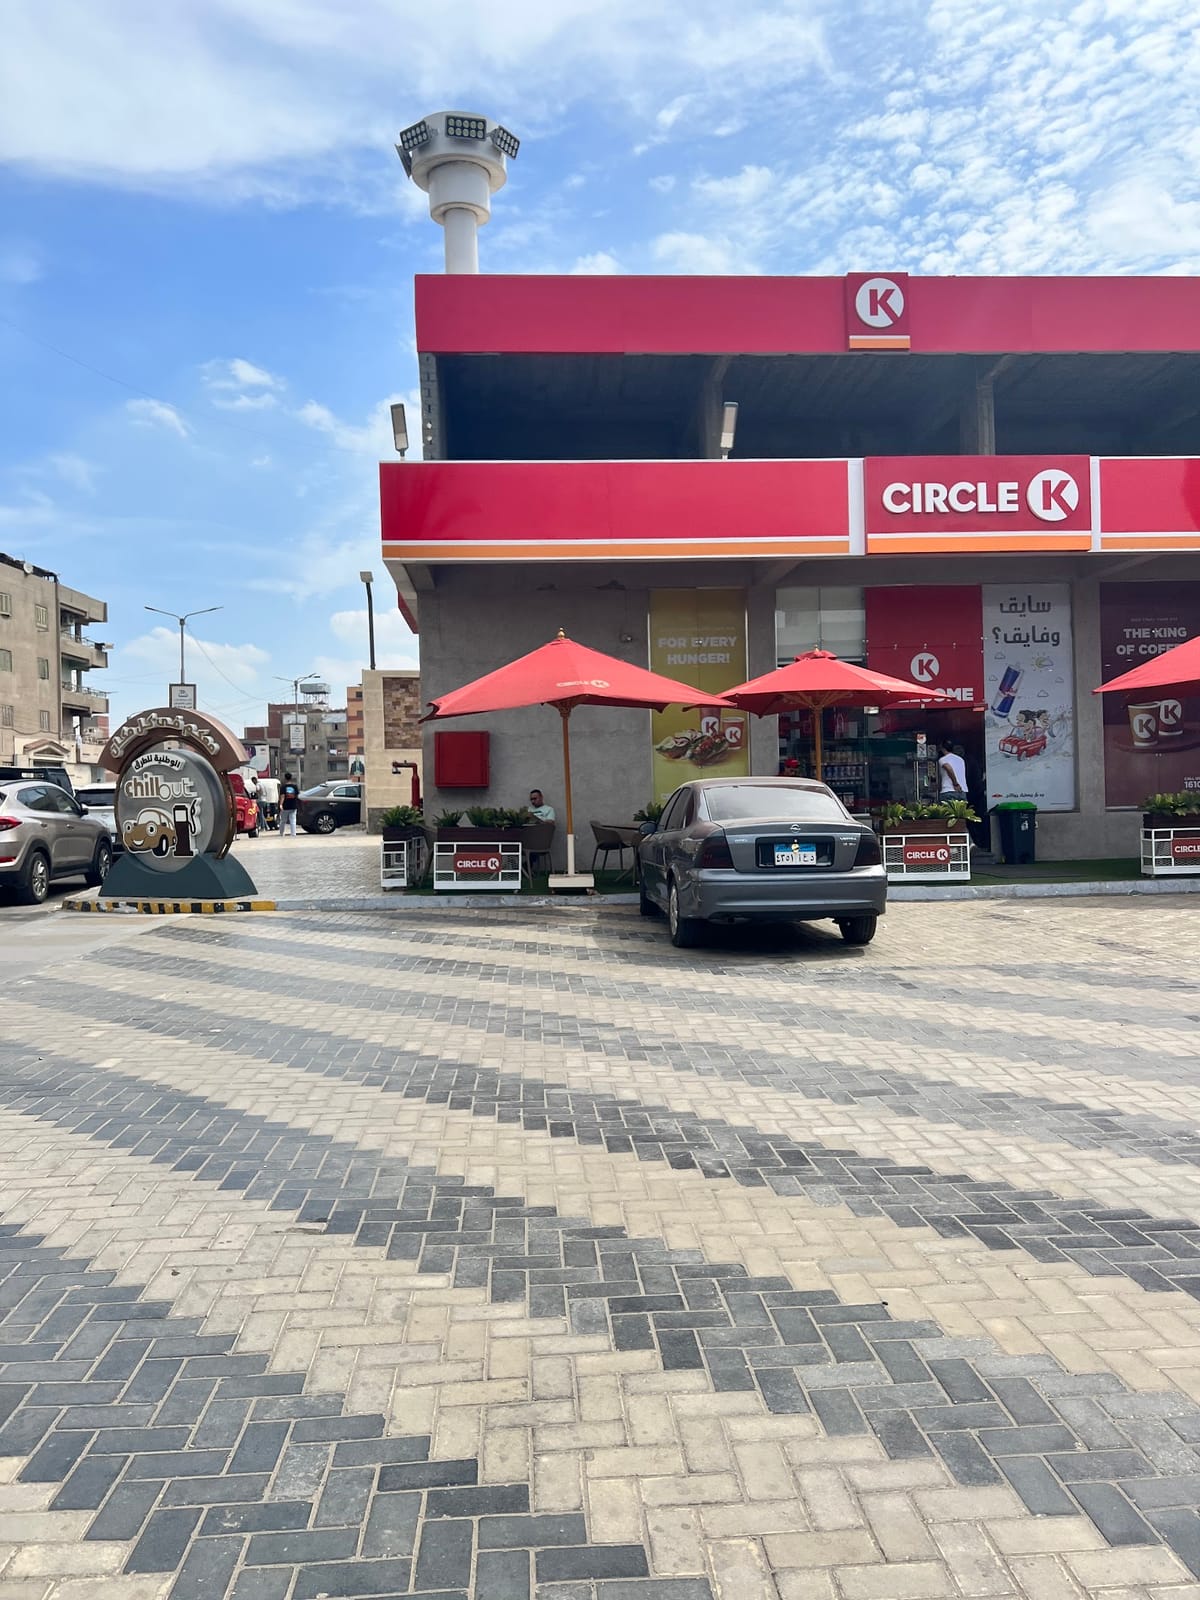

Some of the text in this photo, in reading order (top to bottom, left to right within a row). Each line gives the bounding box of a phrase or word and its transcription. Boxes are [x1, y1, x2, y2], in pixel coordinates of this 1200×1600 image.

[882, 481, 1019, 513] CIRCLE
[1000, 594, 1051, 618] سايق
[992, 625, 1060, 648] وفايق؟
[1123, 626, 1187, 639] THE KING
[658, 636, 737, 648] FOR EVERY
[1116, 644, 1135, 655] OF
[667, 653, 730, 665] HUNGER!
[134, 754, 181, 770] الوطنية للطرق
[906, 849, 948, 860] CIRCLE K
[457, 858, 499, 869] CIRCLE K
